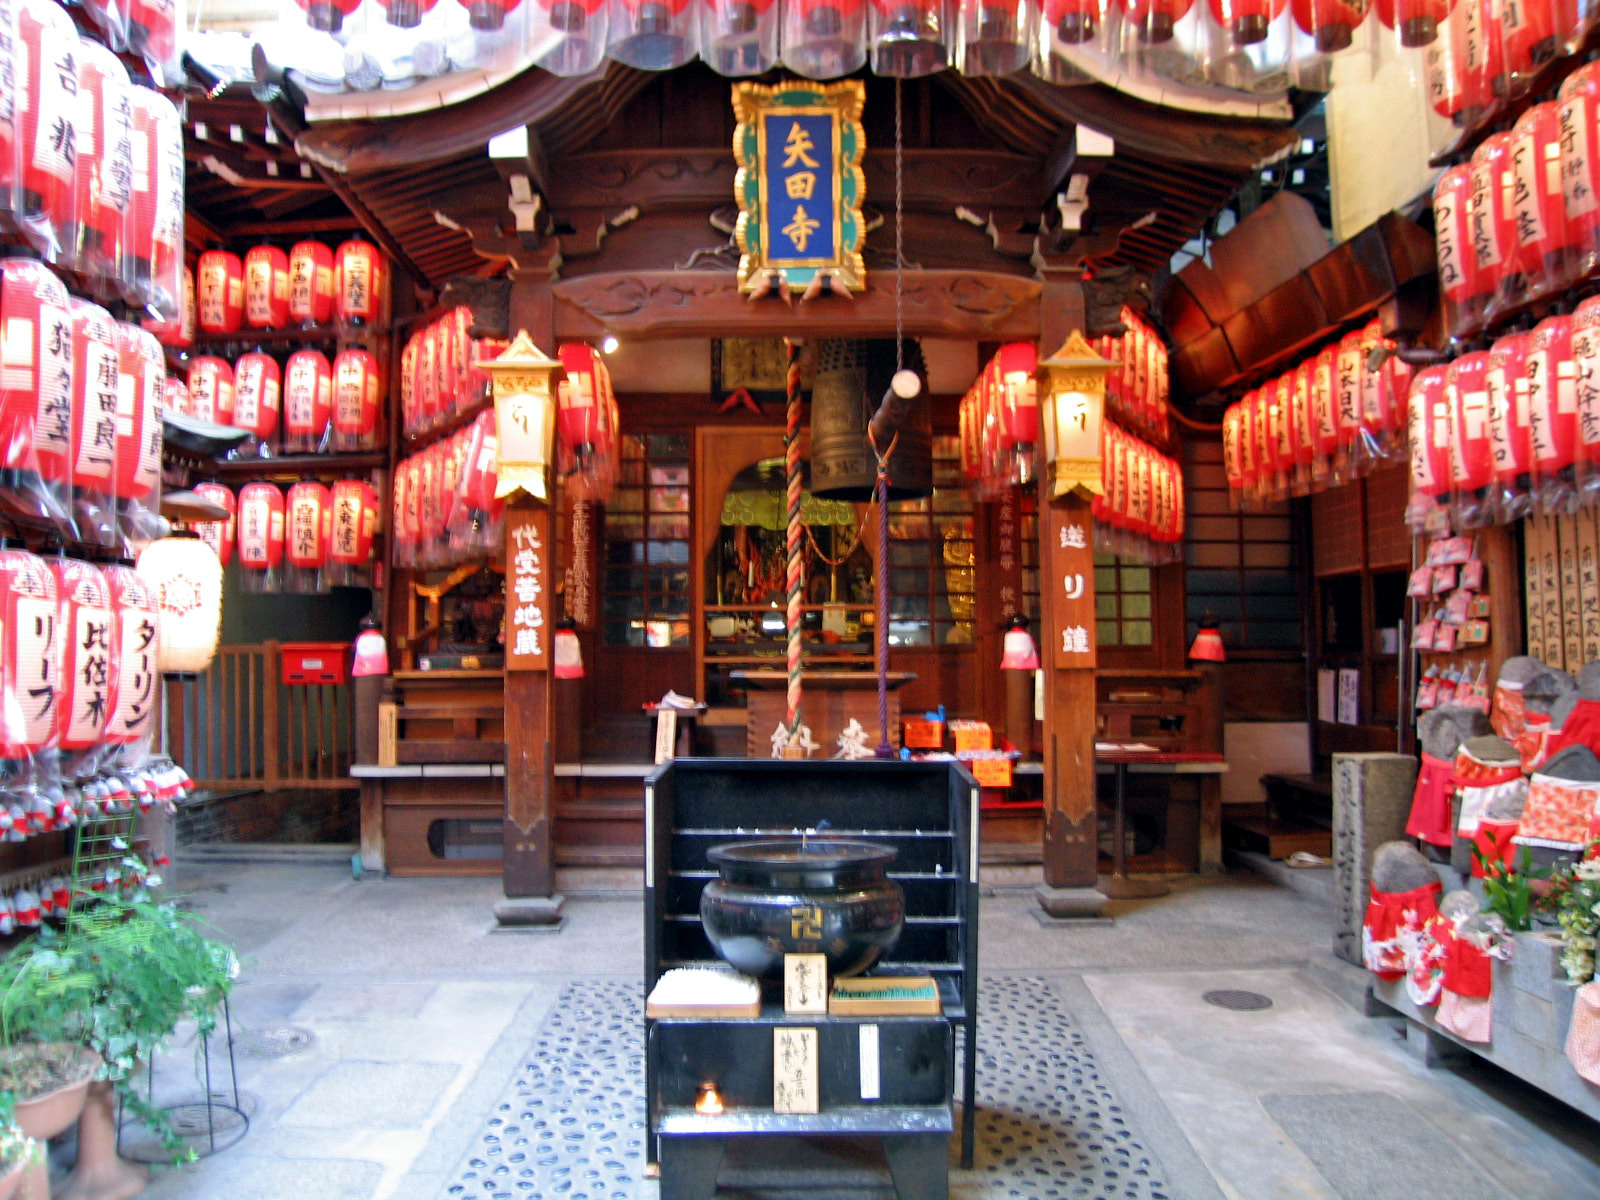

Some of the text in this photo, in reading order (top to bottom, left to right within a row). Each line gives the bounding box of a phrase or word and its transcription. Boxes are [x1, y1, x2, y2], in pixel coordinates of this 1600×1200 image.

[781, 121, 820, 252] 矢田寺
[512, 523, 544, 656] 代受苦地蔵
[1060, 523, 1091, 653] 送り鐘
[28, 615, 54, 721] リーフ
